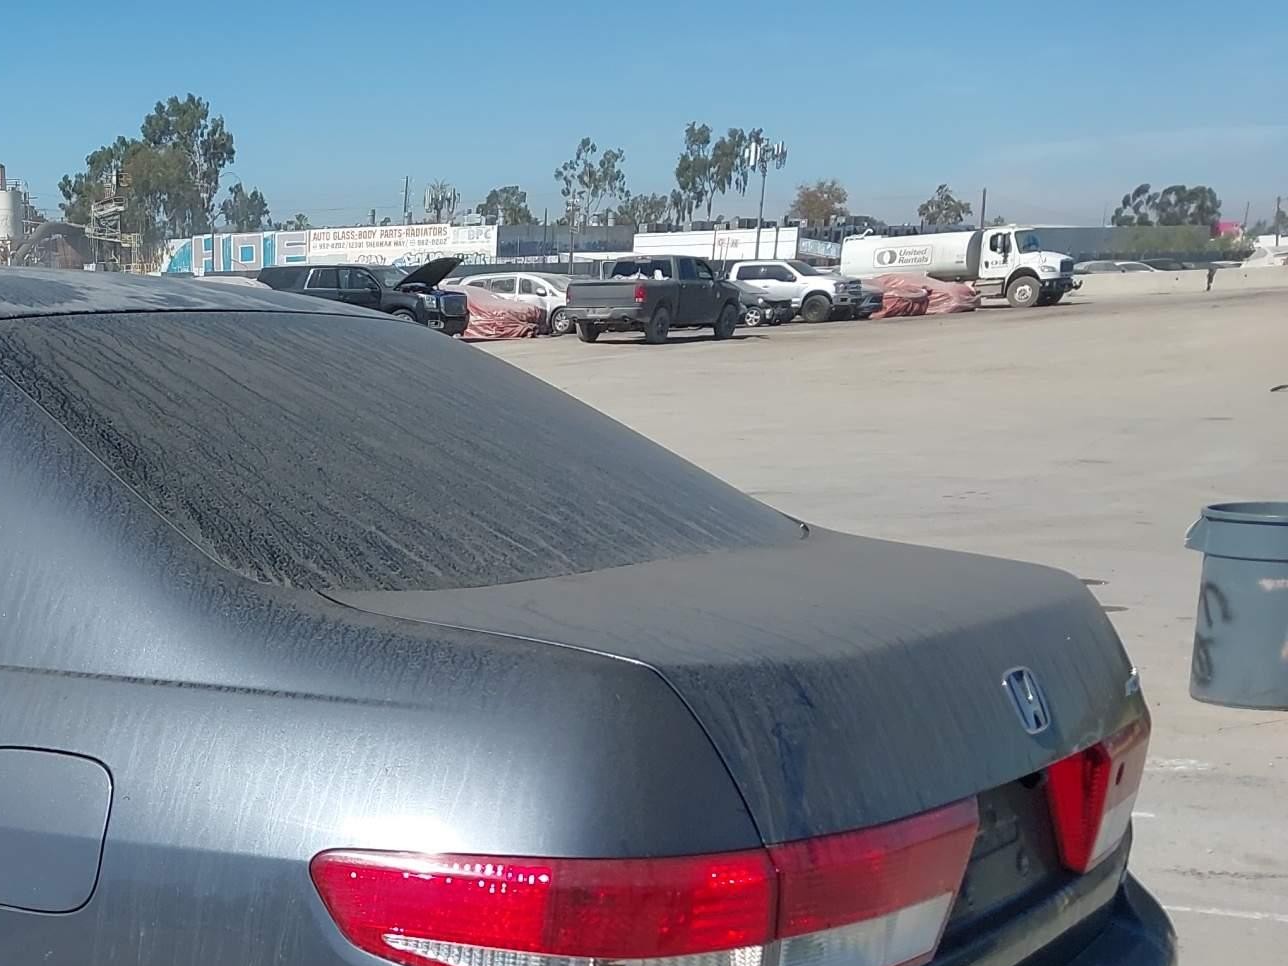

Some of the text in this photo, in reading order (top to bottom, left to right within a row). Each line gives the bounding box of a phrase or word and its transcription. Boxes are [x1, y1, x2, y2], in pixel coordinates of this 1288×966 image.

[312, 231, 331, 241] AUTO
[898, 247, 929, 257] United
[897, 255, 930, 265] Rentals
